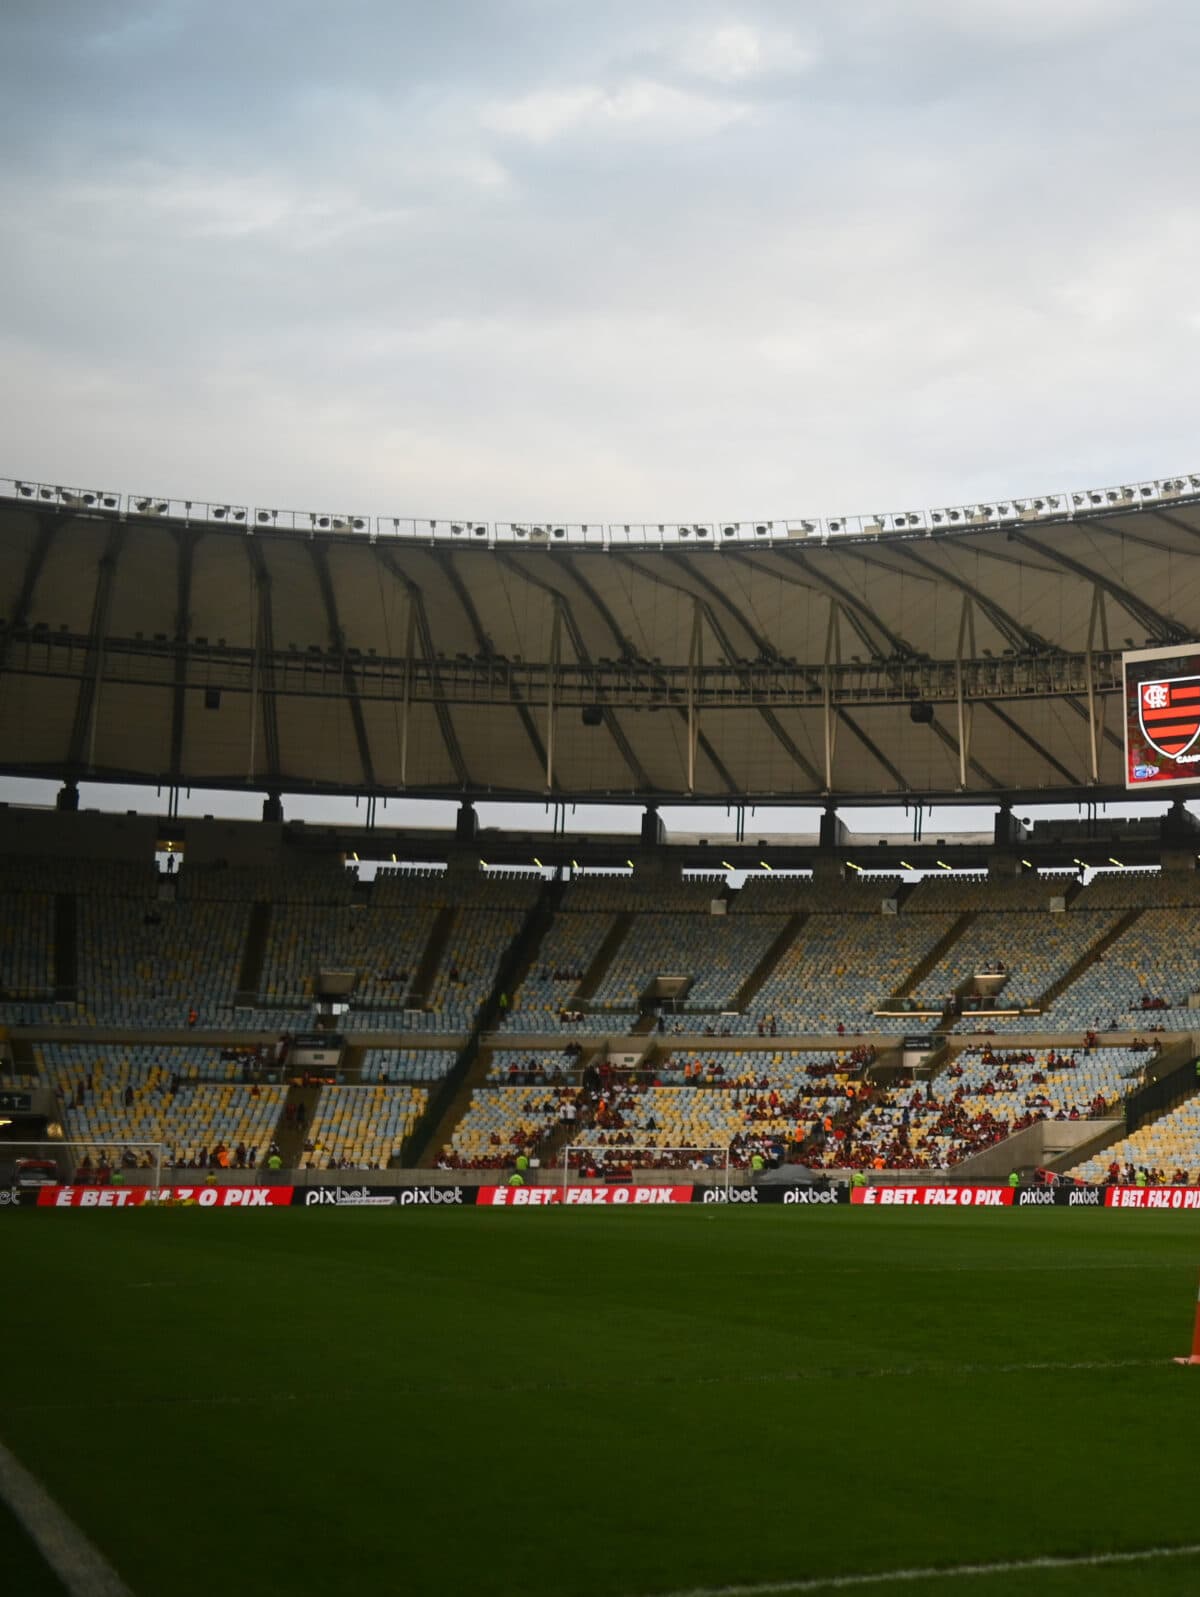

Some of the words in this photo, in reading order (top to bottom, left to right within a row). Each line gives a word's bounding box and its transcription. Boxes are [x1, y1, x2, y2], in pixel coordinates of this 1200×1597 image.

[56, 1186, 75, 1206] É
[80, 1190, 135, 1206] BET.
[198, 1189, 218, 1206] O
[224, 1189, 273, 1206] PIX.
[306, 1187, 371, 1206] pixbet
[401, 1186, 462, 1205] pixbet
[492, 1186, 508, 1205] É
[512, 1188, 560, 1205] BET.
[566, 1188, 608, 1204] FAZ
[612, 1188, 629, 1204] O
[634, 1188, 676, 1204] PIX.
[703, 1186, 758, 1204] pixbet
[783, 1187, 838, 1204] pixbet
[863, 1187, 878, 1205] É
[880, 1189, 919, 1205] BET.
[924, 1189, 957, 1205] FAZ
[960, 1189, 972, 1205] O
[975, 1189, 1003, 1206] PIX.
[1020, 1187, 1055, 1206] pixbet
[1069, 1187, 1099, 1207] pixbet
[1111, 1187, 1121, 1207] É
[1121, 1190, 1145, 1208] BET.
[1147, 1190, 1171, 1207] FAZ
[1173, 1190, 1182, 1208] O
